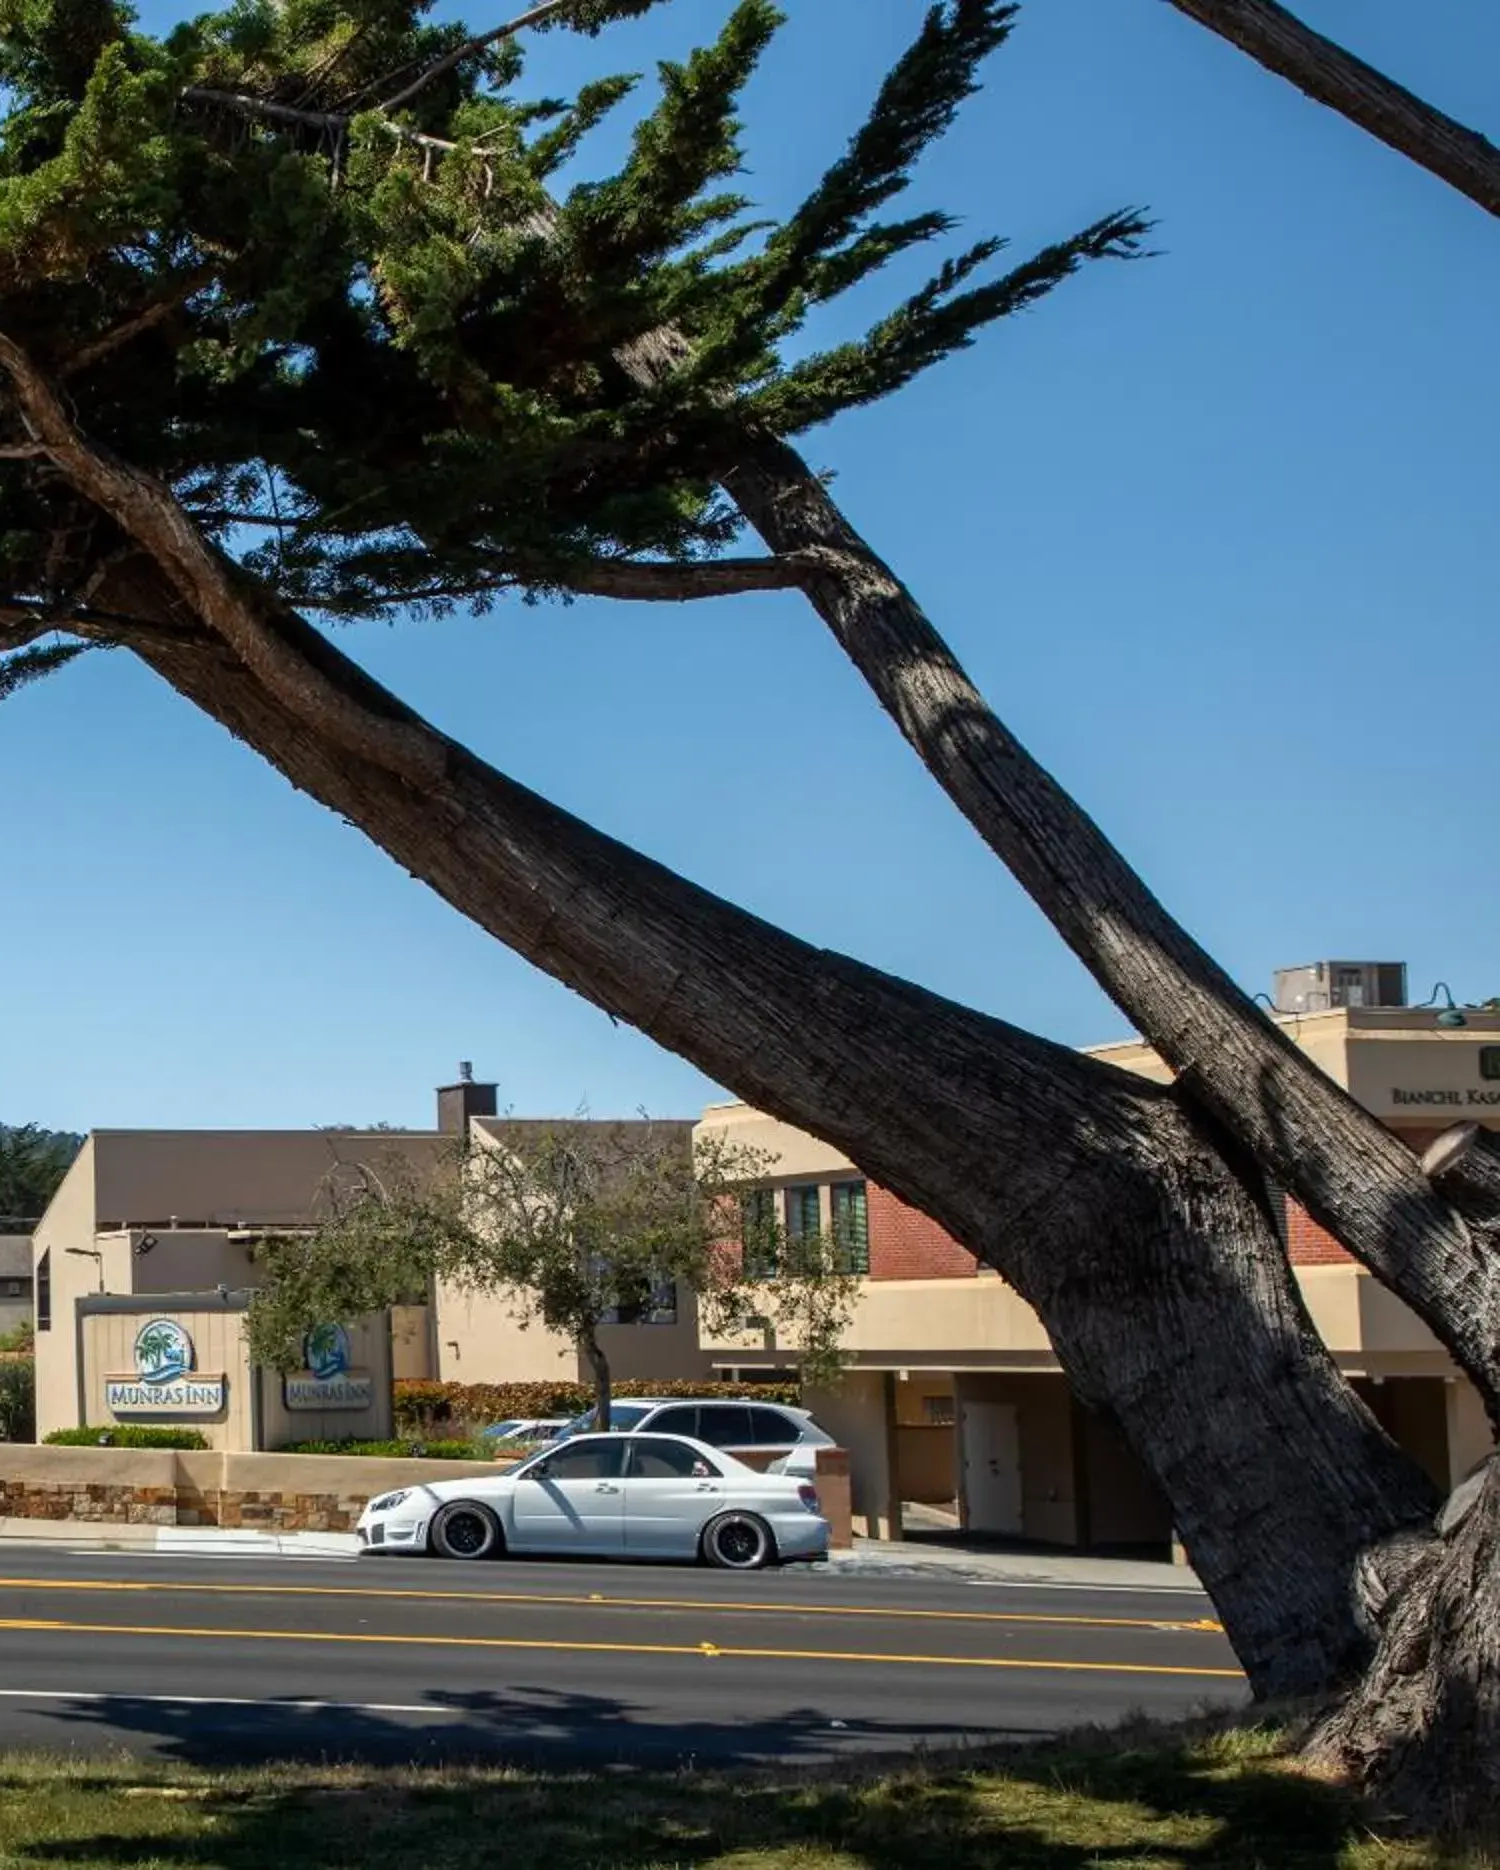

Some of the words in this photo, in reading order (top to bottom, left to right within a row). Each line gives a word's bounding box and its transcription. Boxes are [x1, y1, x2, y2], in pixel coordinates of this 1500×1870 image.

[111, 1385, 184, 1405] MUNRAS
[186, 1384, 220, 1405] INN
[289, 1383, 344, 1402] MUNRAS
[346, 1382, 372, 1401] INN
